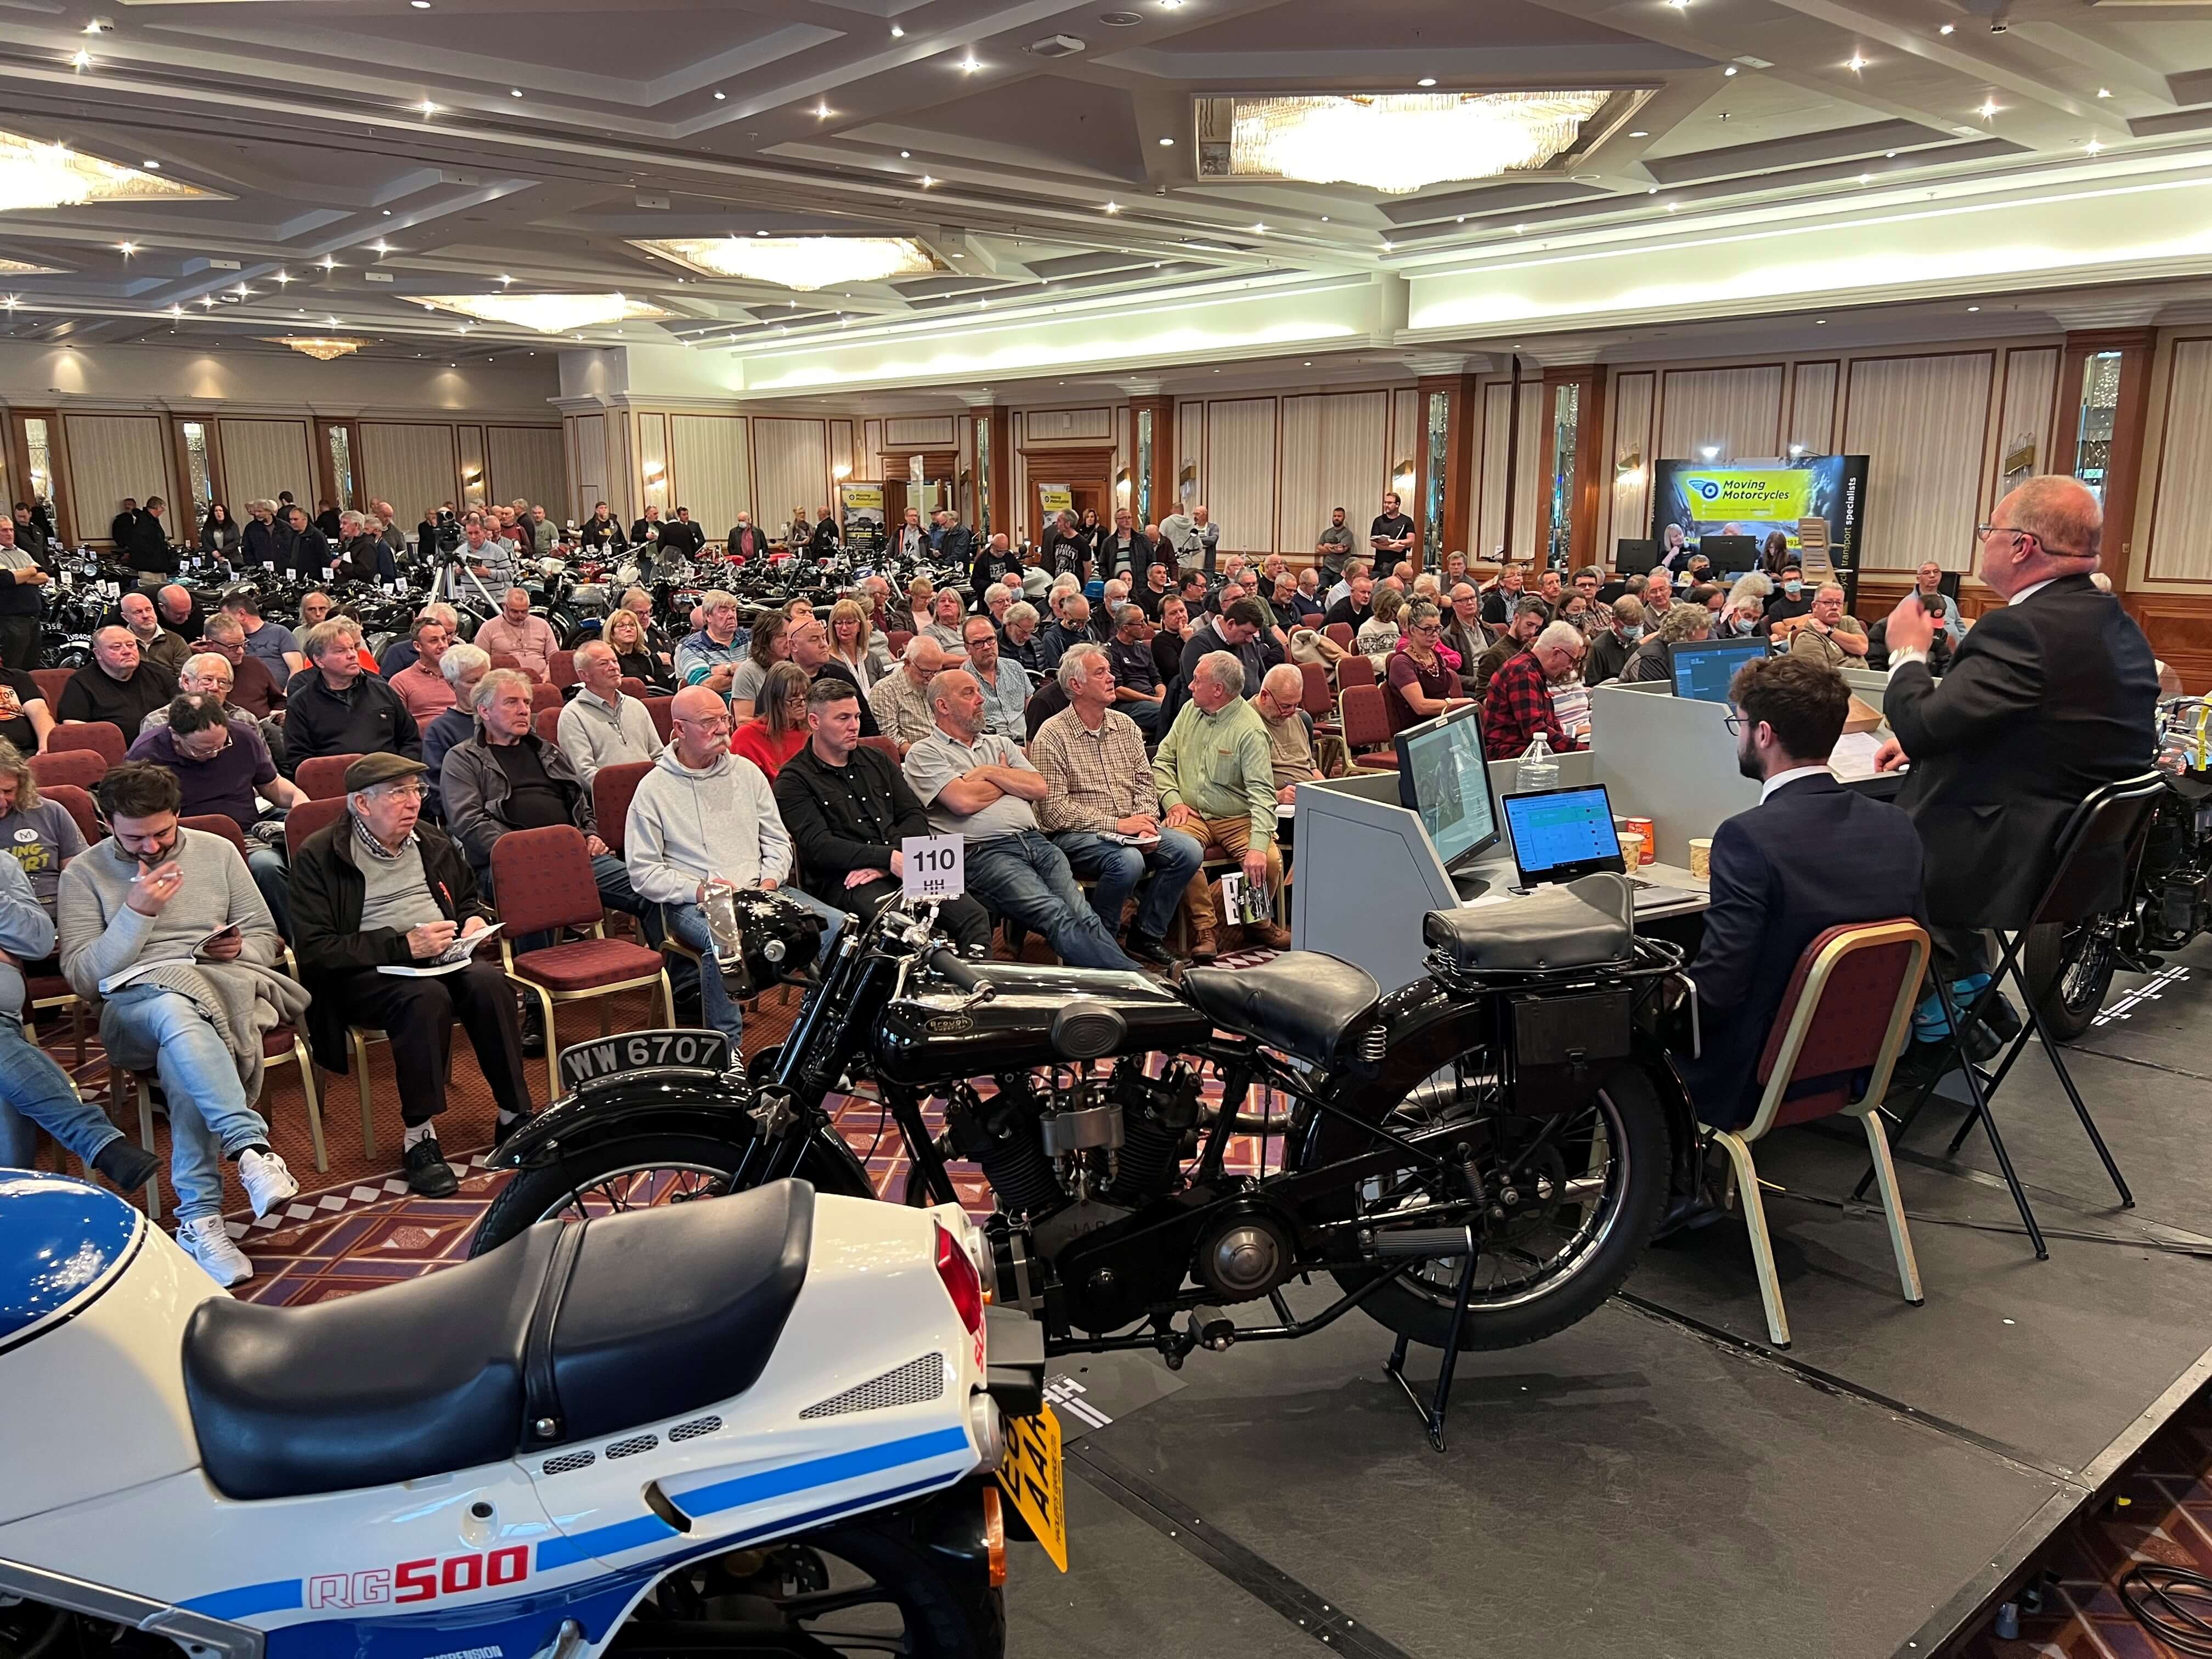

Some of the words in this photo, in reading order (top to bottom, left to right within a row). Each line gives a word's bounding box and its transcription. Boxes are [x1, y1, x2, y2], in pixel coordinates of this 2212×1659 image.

[1723, 479, 1765, 490] Moving
[1723, 490, 1789, 501] Motorcycles
[1845, 477, 1857, 525] specialists
[1842, 527, 1852, 566] transport
[913, 848, 955, 872] 110
[930, 1018, 968, 1027] Brough
[566, 1043, 617, 1080] WW
[628, 1036, 721, 1065] 6707
[310, 1544, 528, 1610] RG500
